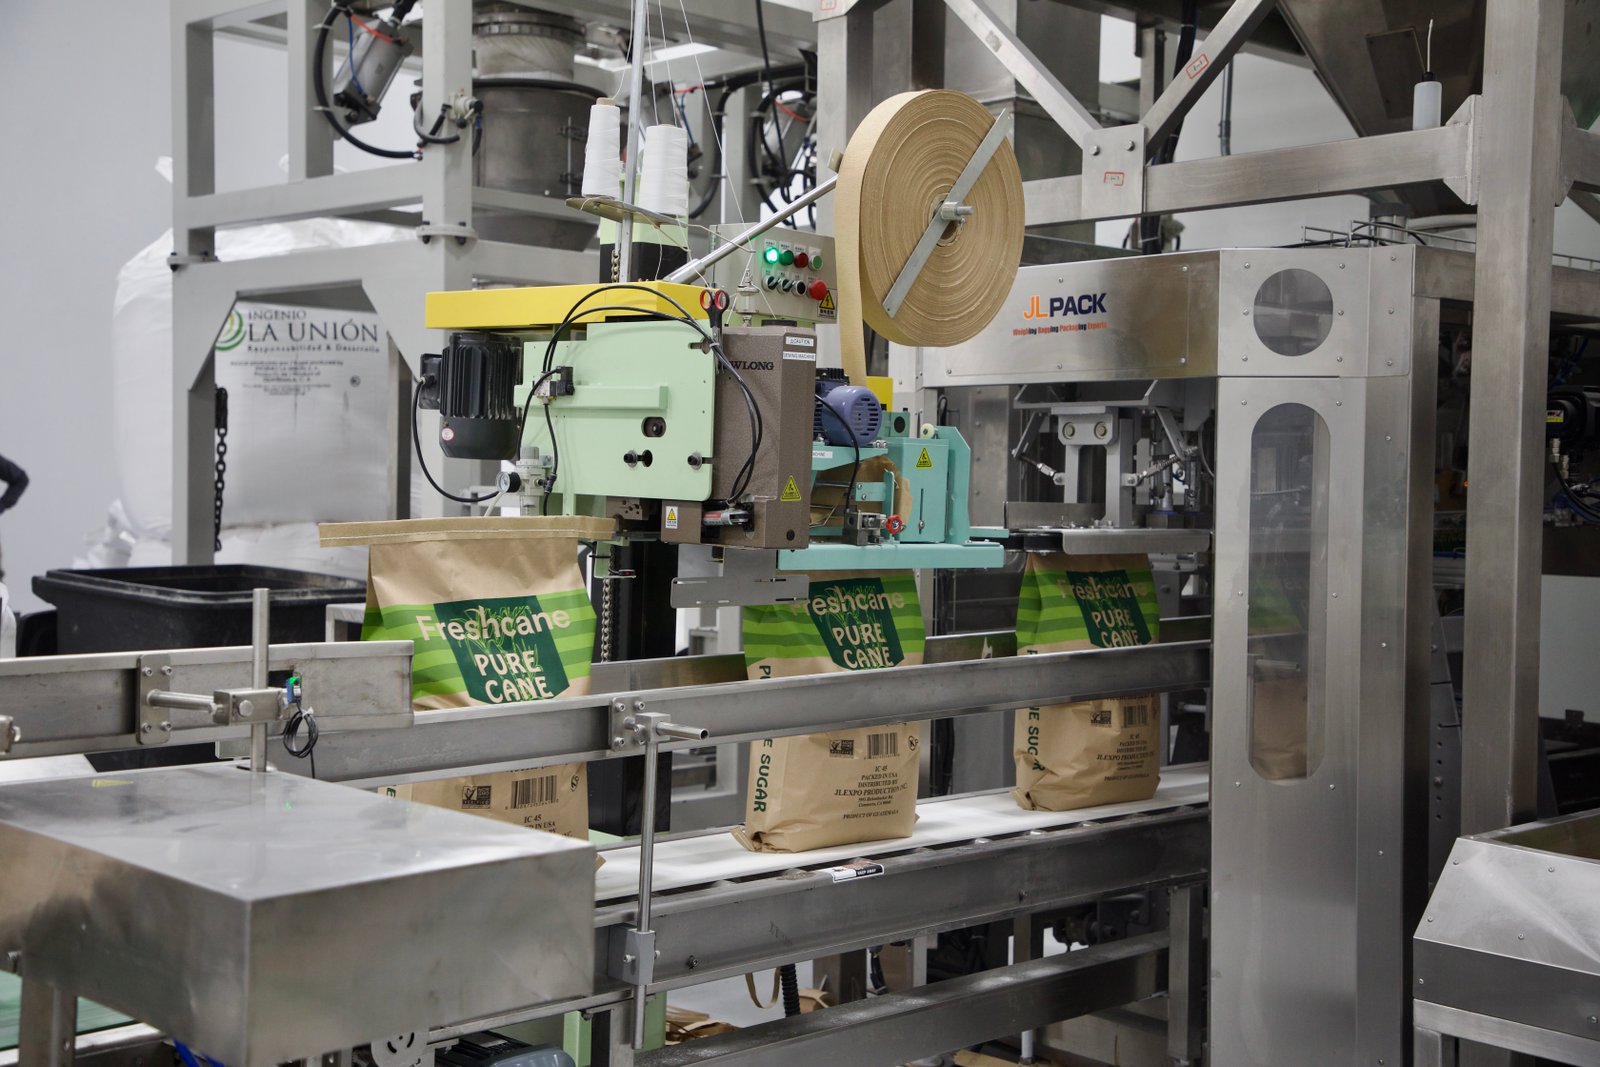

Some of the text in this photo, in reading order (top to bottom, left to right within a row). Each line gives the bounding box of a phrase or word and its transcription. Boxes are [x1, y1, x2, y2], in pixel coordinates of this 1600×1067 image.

[248, 310, 307, 320] INGENIO
[248, 318, 378, 343] LA UNIÓN
[718, 360, 775, 371] WLONG
[1057, 576, 1148, 600] Freshcane
[416, 605, 571, 641] Freshcane
[1091, 608, 1135, 628] PURE
[832, 623, 887, 647] PURE
[1101, 629, 1142, 648] CANE
[474, 650, 542, 677] PURE
[842, 646, 894, 669] CANE
[485, 676, 555, 704] CANE
[753, 753, 771, 813] SUGAR
[858, 780, 891, 788] DISTRIBUTED
[533, 814, 542, 822] 45
